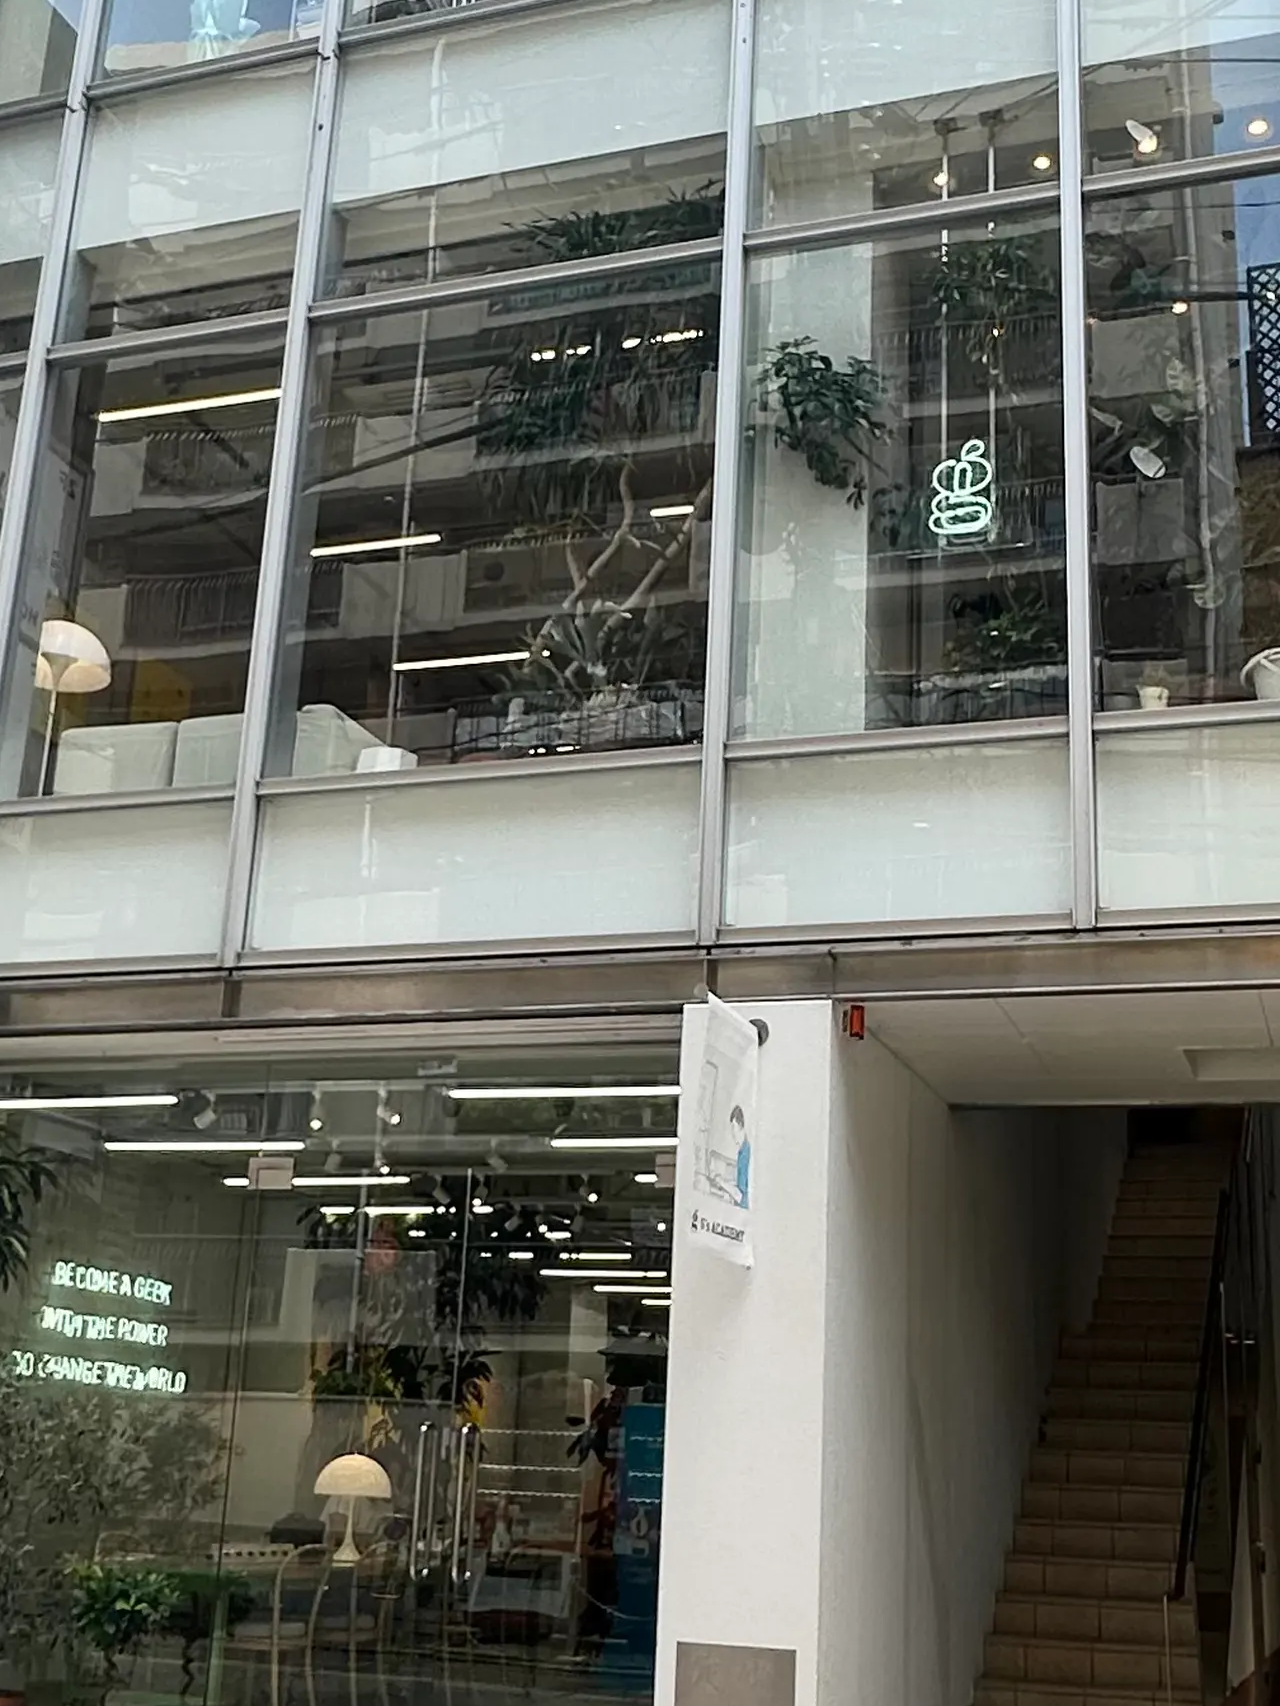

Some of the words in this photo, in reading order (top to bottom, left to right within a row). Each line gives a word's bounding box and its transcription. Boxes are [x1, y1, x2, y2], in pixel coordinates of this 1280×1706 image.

[51, 1261, 119, 1295] BECOME
[119, 1273, 132, 1297] A
[133, 1276, 173, 1307] GEEK
[83, 1314, 117, 1340] THE
[118, 1317, 169, 1347] POWER
